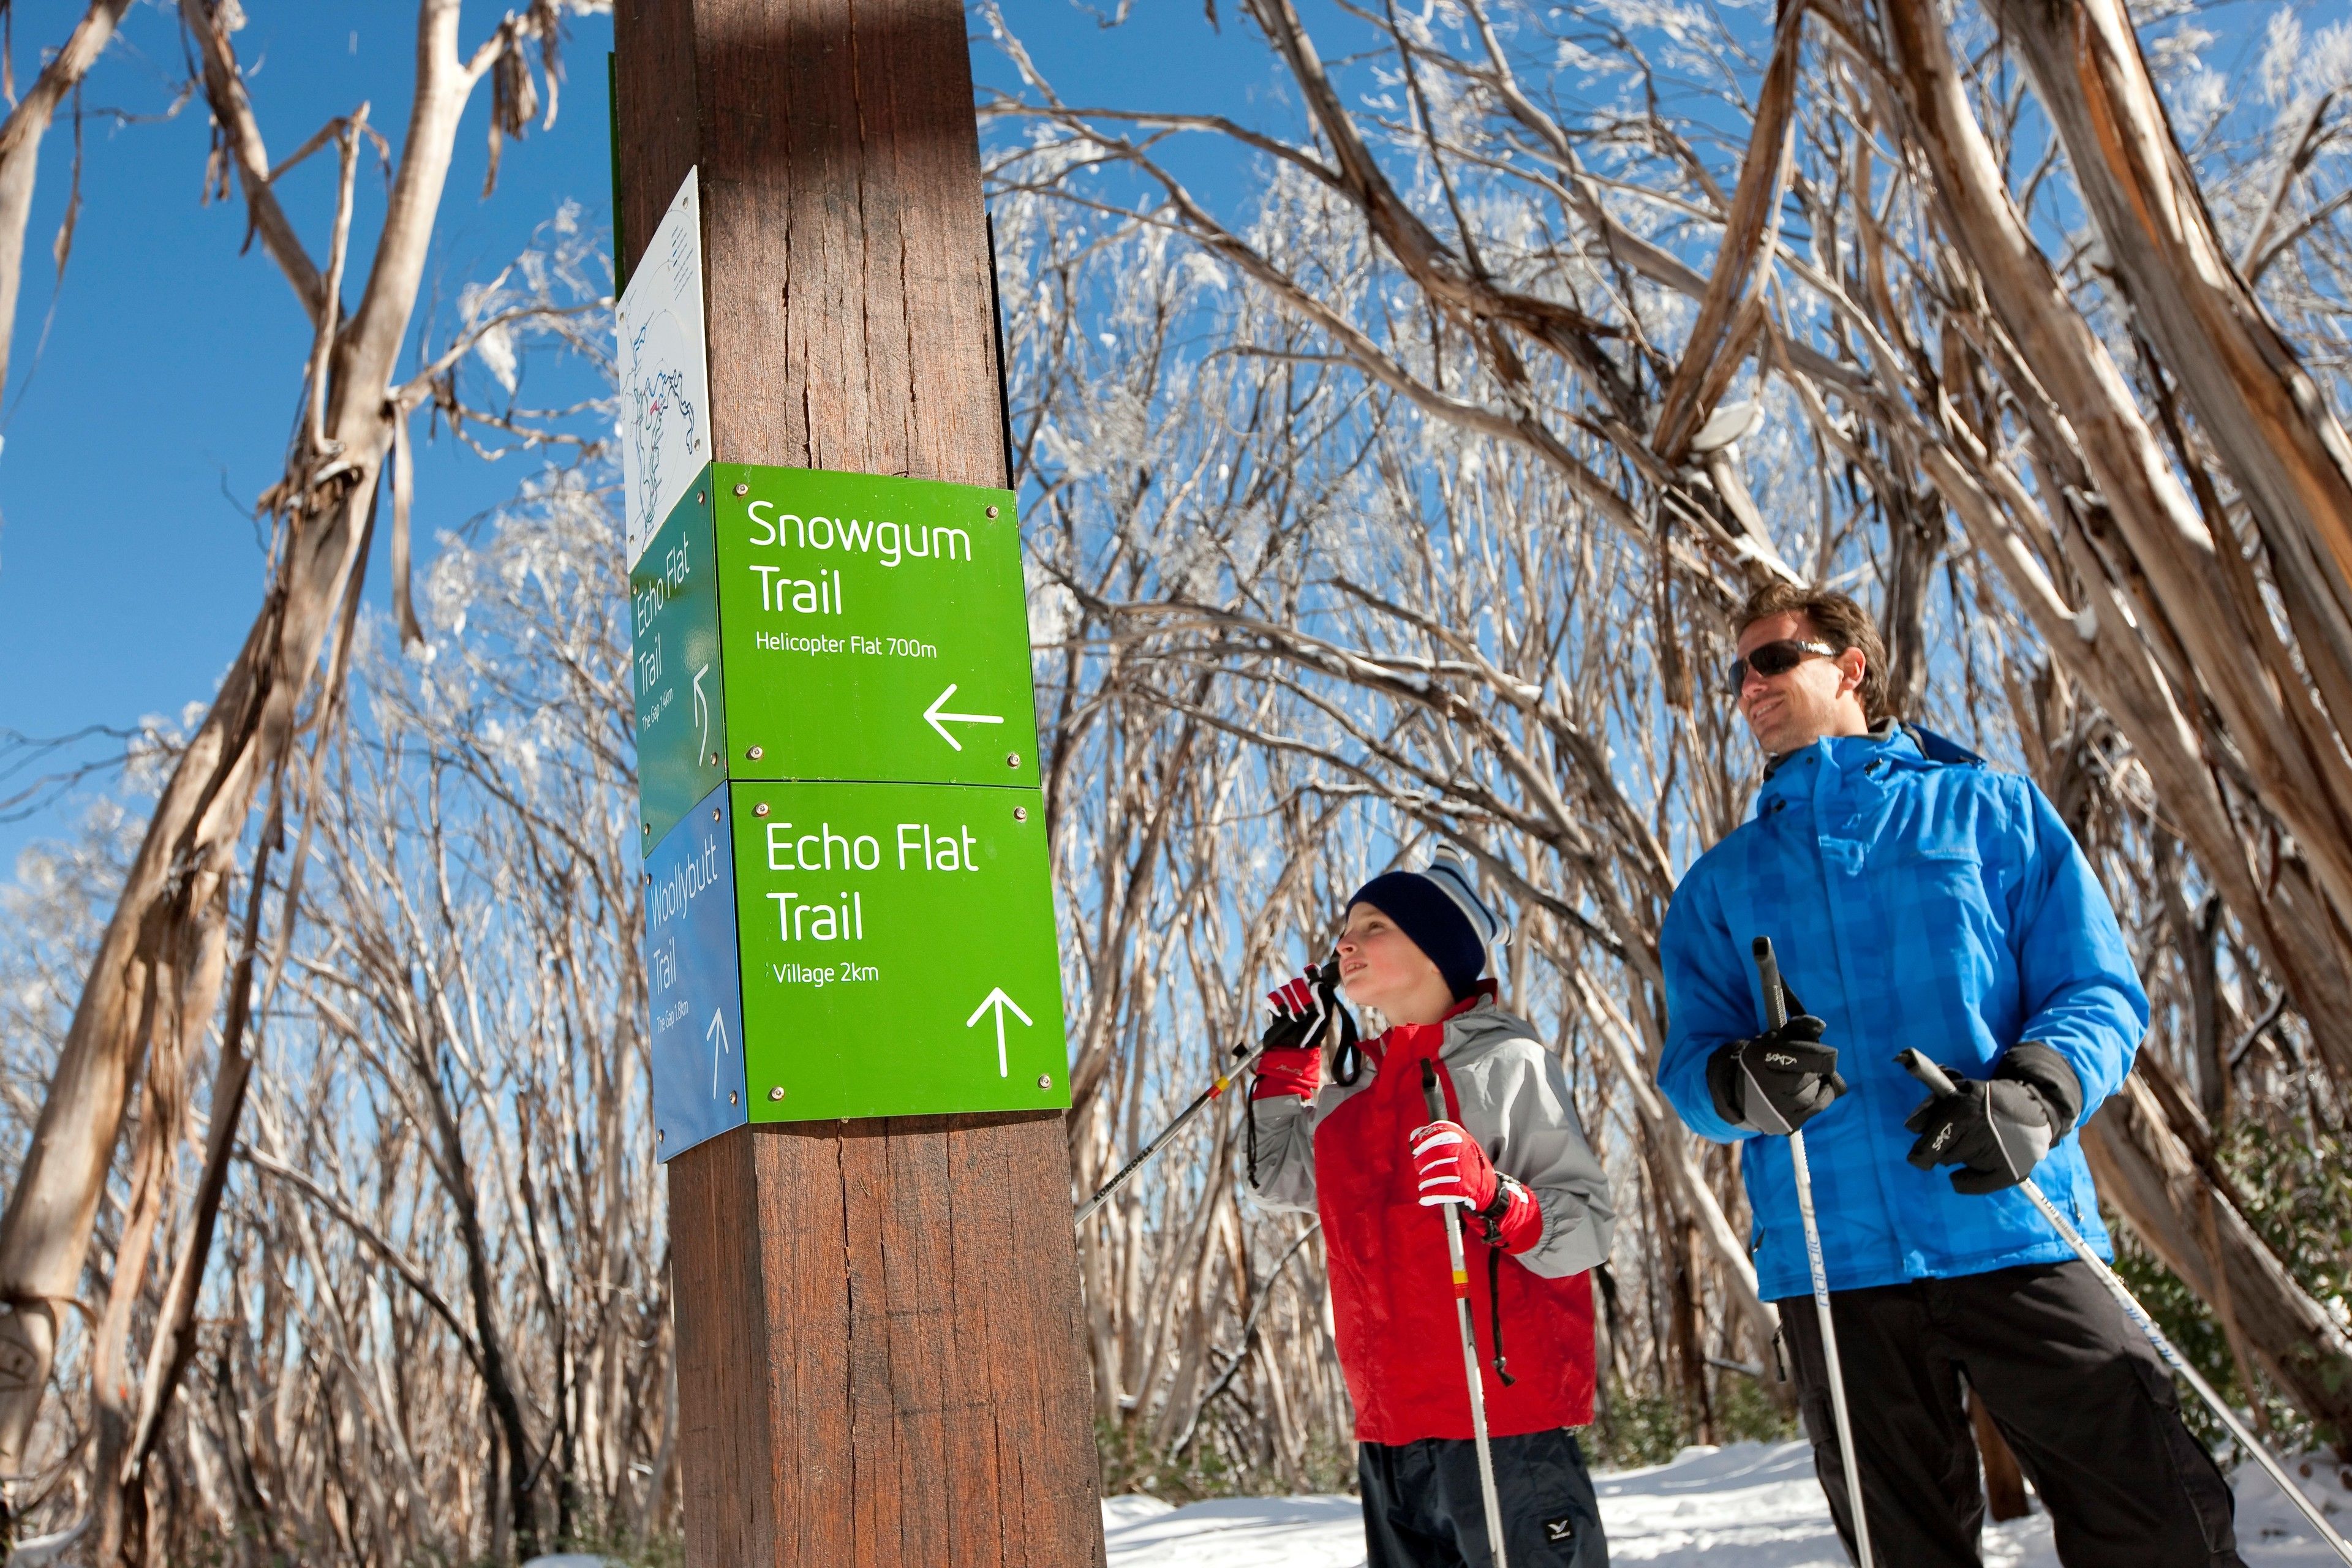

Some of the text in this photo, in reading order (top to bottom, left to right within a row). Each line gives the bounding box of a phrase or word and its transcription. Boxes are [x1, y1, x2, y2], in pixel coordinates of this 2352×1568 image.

[747, 500, 972, 567] Snowgum
[638, 531, 691, 638] Echo Flat
[748, 565, 842, 615] Trail
[638, 632, 663, 697] Trail
[756, 631, 938, 658] Helicopter Flat 700m
[641, 687, 673, 733] The Gap 1.4km
[766, 822, 979, 872] Echo Flat
[650, 833, 718, 932] Woollybutt
[766, 891, 863, 942] Trail
[653, 935, 677, 996] Trail
[772, 962, 880, 988] Village 2km
[656, 999, 689, 1034] The Gap 1.8km
